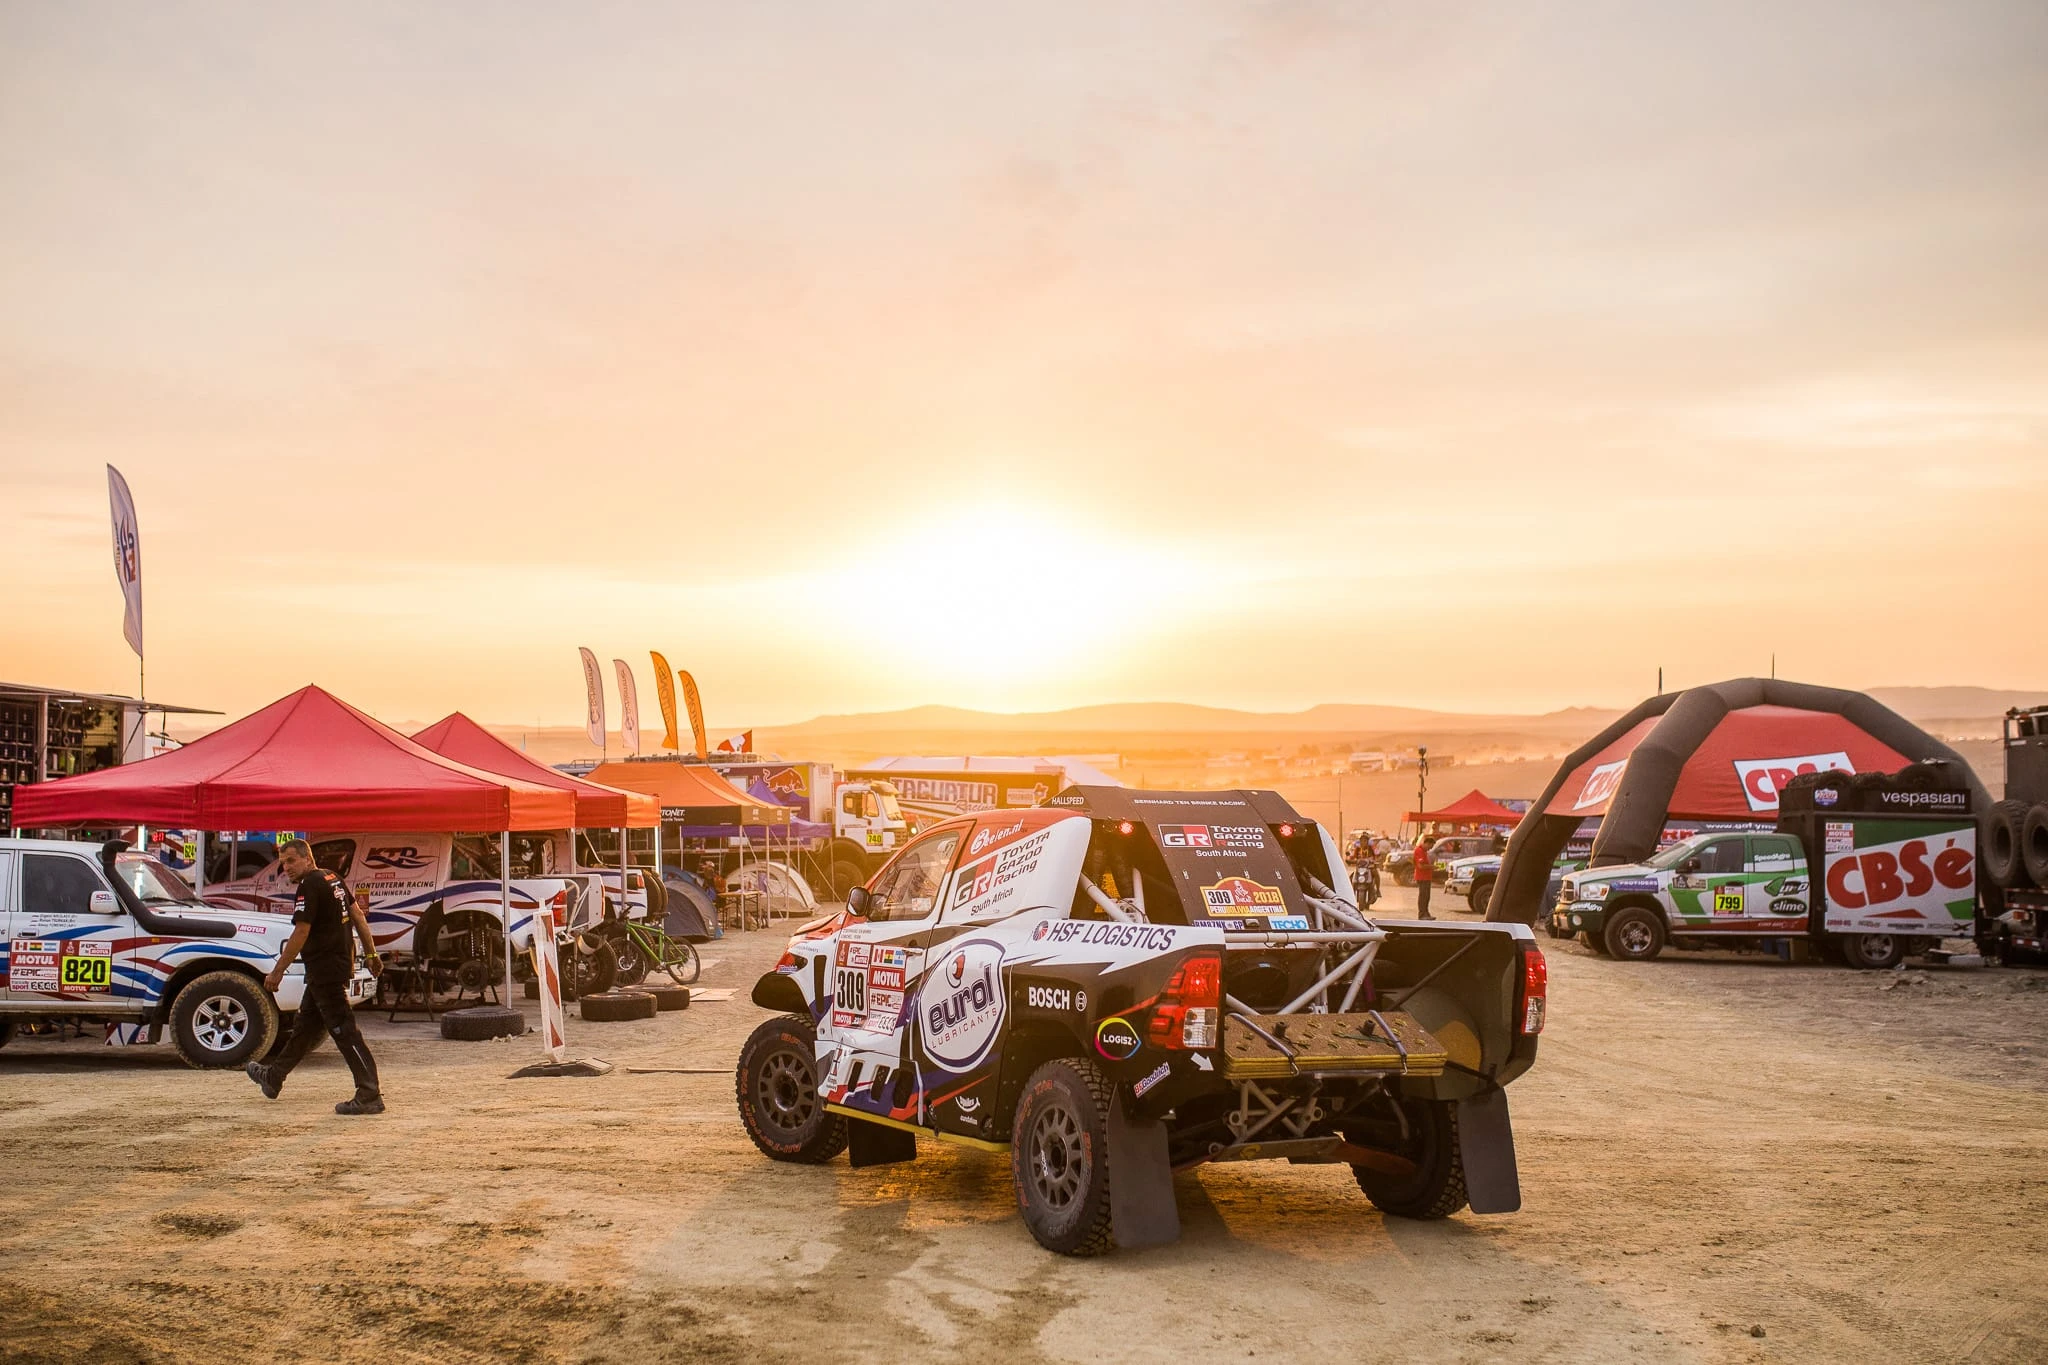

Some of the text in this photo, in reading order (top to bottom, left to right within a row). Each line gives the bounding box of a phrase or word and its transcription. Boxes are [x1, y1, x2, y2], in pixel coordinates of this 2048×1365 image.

[1051, 796, 1085, 805] HALLSPEED
[1882, 791, 1965, 807] vespasiani
[660, 808, 685, 818] TONET
[1211, 825, 1264, 834] TOYOTA
[1213, 833, 1262, 841] GAZOO
[1002, 831, 1050, 861] TOYOTA
[1163, 833, 1211, 847] GR
[1218, 839, 1264, 849] Racing
[997, 846, 1042, 874] GAZOO
[993, 860, 1038, 887] Racing
[1826, 838, 1974, 909] CBSé
[356, 881, 404, 889] KONTURTERM
[955, 871, 992, 905] GR
[970, 887, 1014, 916] South Africa
[1208, 891, 1231, 904] 309
[1253, 891, 1279, 903] 2018
[1718, 896, 1740, 909] 799
[1773, 899, 1804, 912] slime
[239, 924, 266, 933] MOTUL
[1047, 922, 1177, 951] HSF LOGISTICS
[15, 955, 54, 965] MOTUL
[65, 959, 106, 983] 820
[872, 970, 901, 987] MOTUL
[837, 970, 864, 1011] 309
[1028, 986, 1071, 1011] BOSCH
[928, 963, 996, 1036] eurol
[931, 1007, 998, 1049] LUBRICANTS
[1103, 1034, 1133, 1046] LOGISZ
